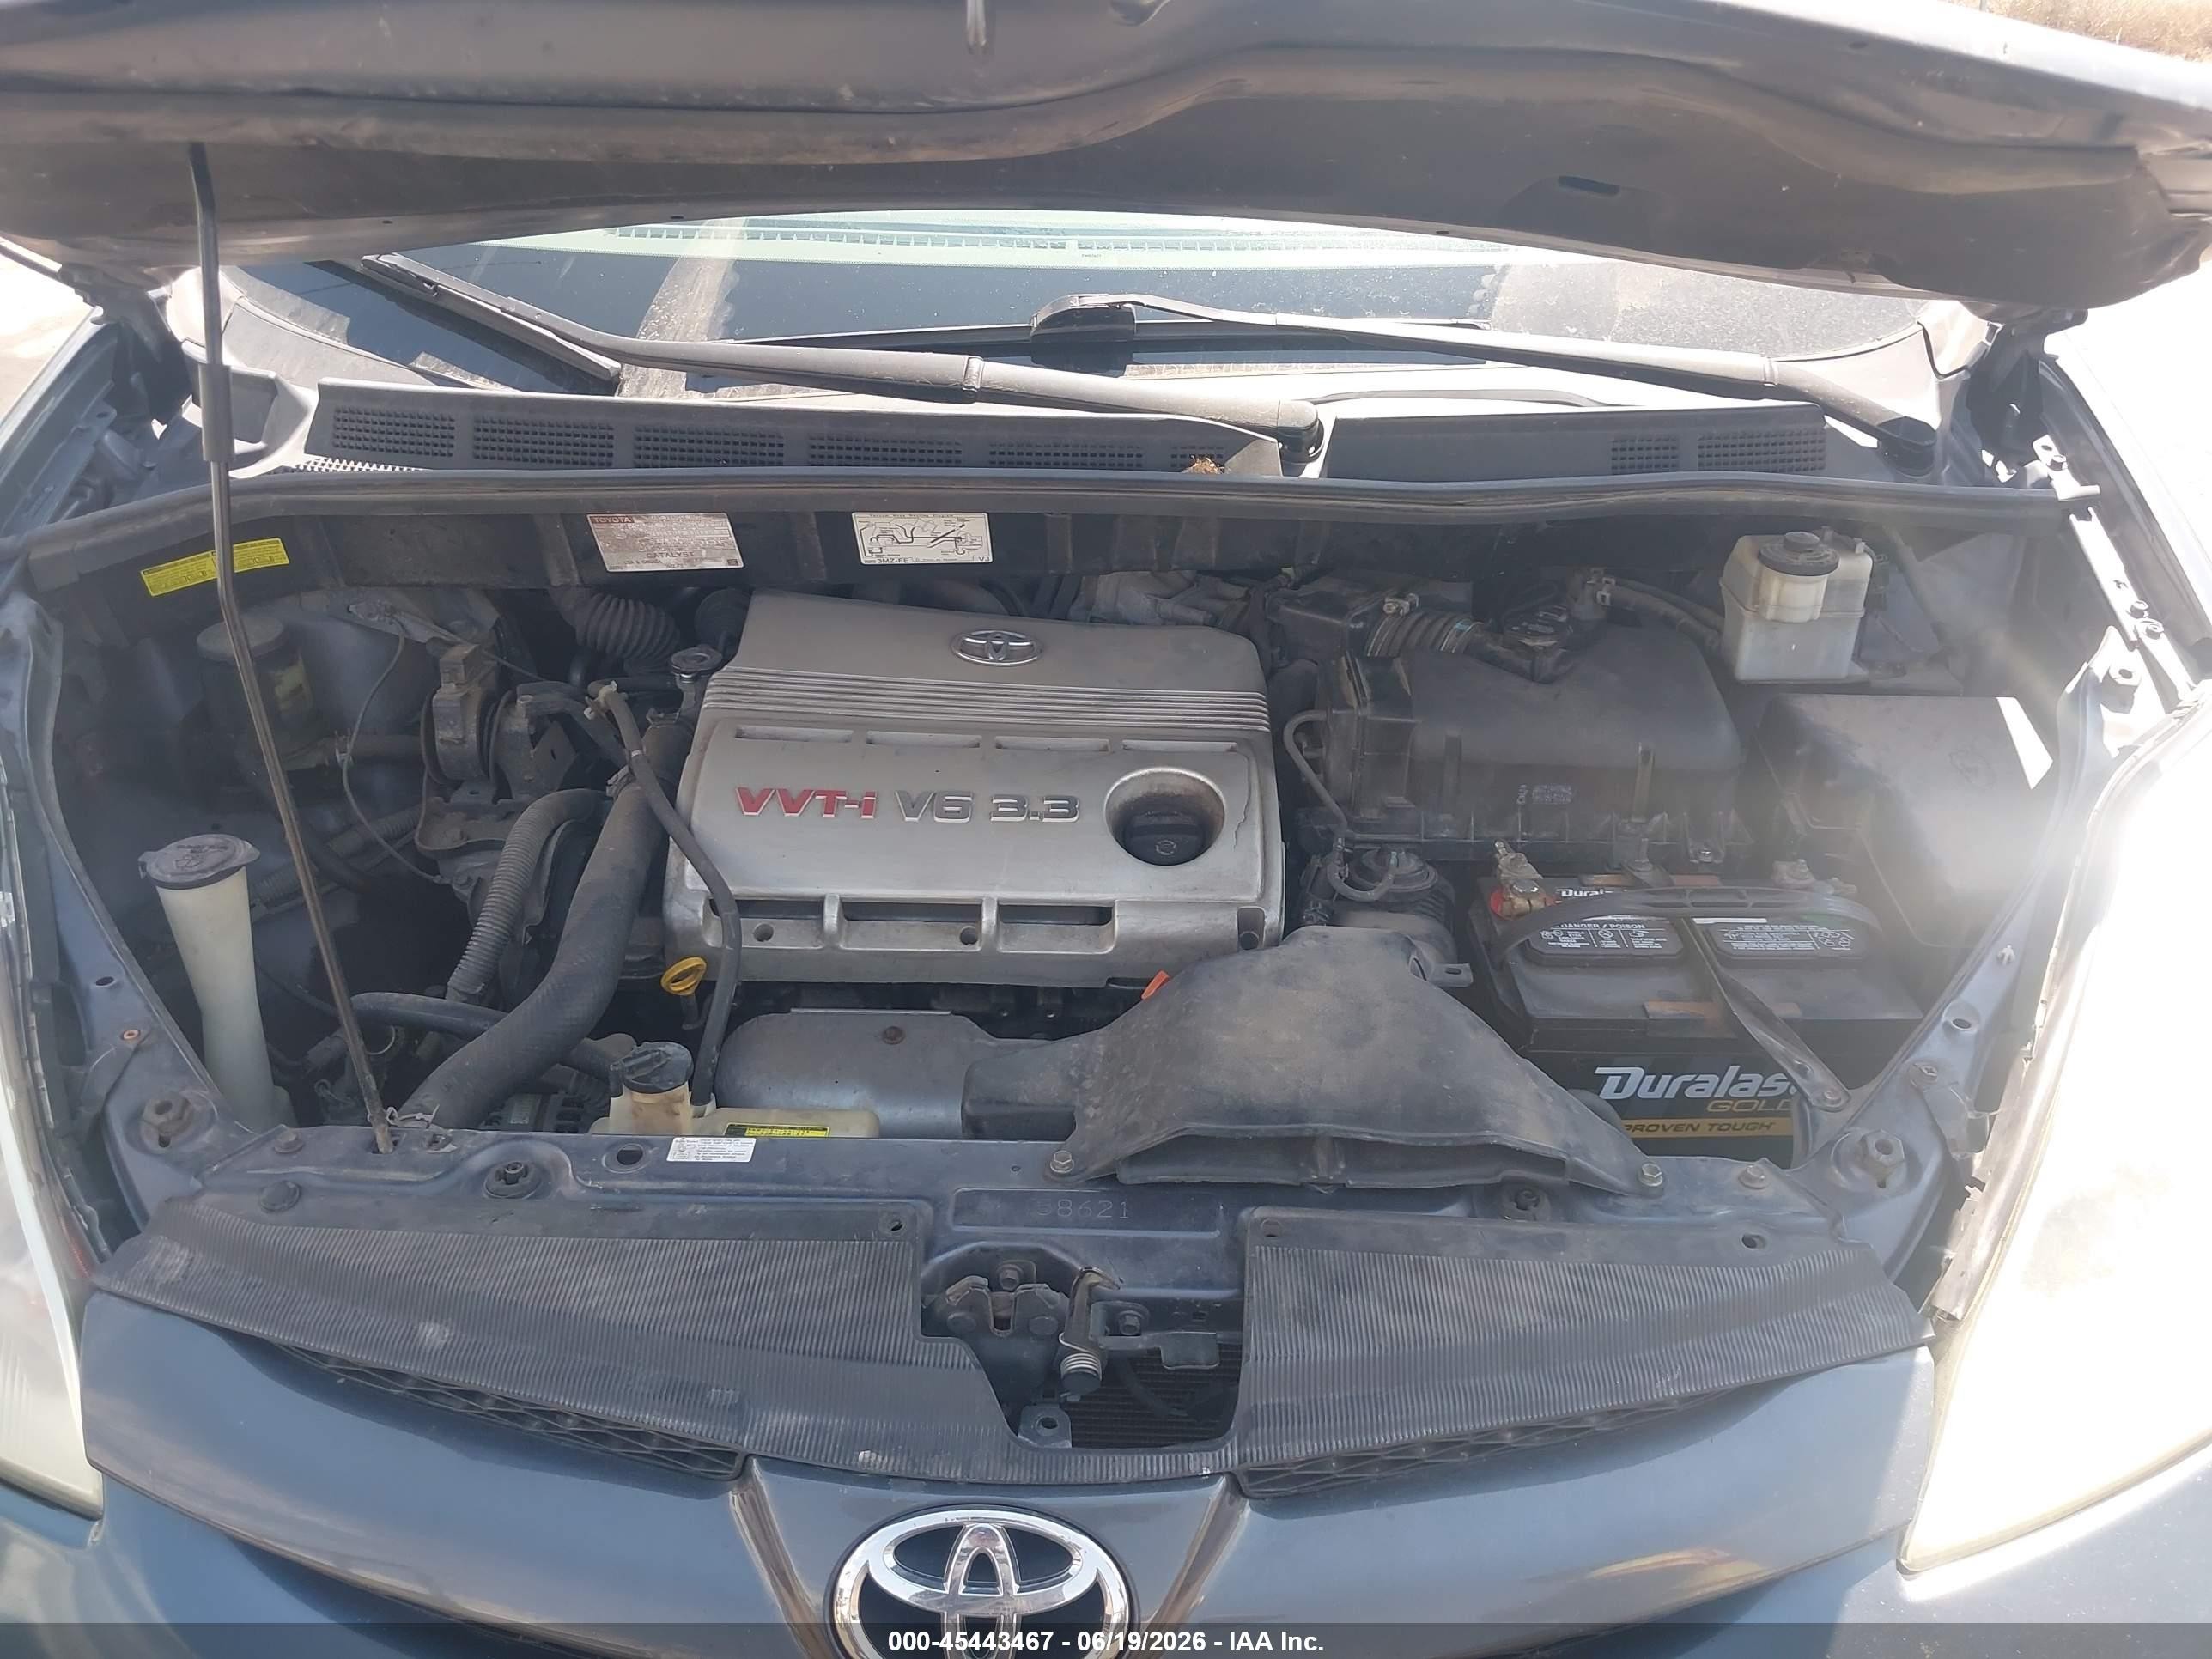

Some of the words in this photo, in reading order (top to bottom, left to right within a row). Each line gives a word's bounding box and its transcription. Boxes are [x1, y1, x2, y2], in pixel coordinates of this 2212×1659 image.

[895, 790, 975, 823] V6
[990, 793, 1080, 823] 3.3
[1556, 887, 1614, 898] Dural
[1594, 1066, 1797, 1100] Duralas
[1706, 1099, 1793, 1113] GOLD
[1708, 1121, 1772, 1132] TOUGH
